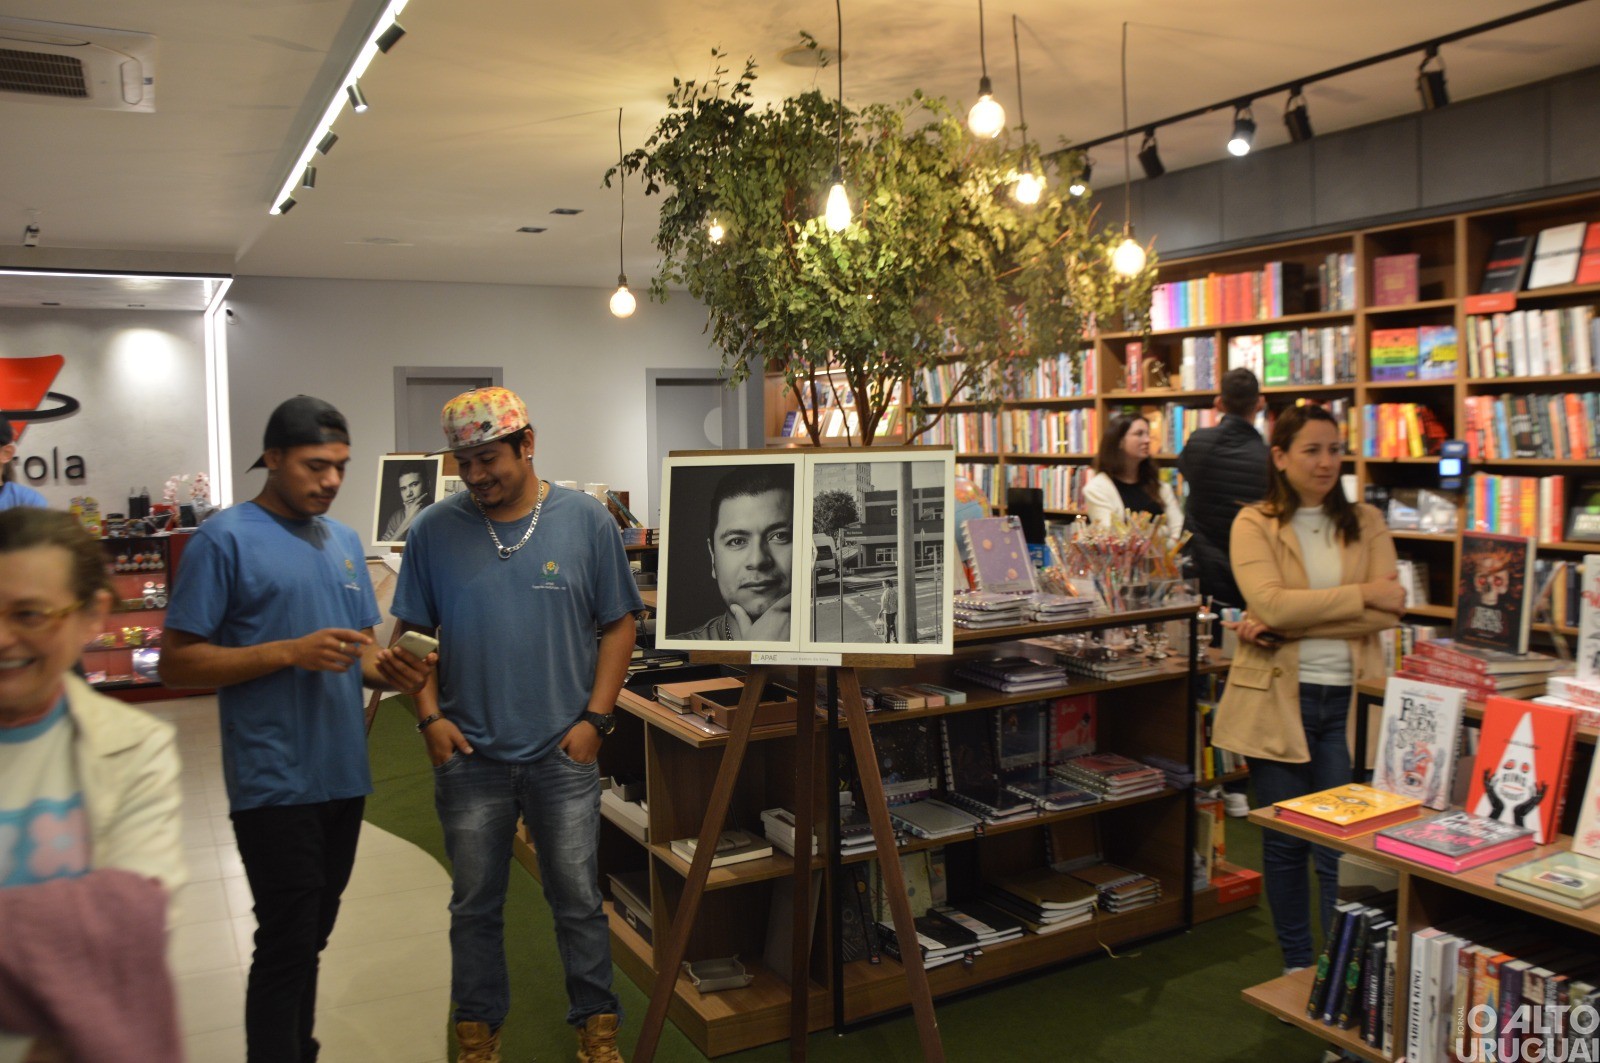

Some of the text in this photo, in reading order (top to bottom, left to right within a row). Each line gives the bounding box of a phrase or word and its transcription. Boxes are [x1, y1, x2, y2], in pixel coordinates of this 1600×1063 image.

[760, 654, 778, 662] APAE
[1410, 969, 1422, 1048] TABITHA KING
